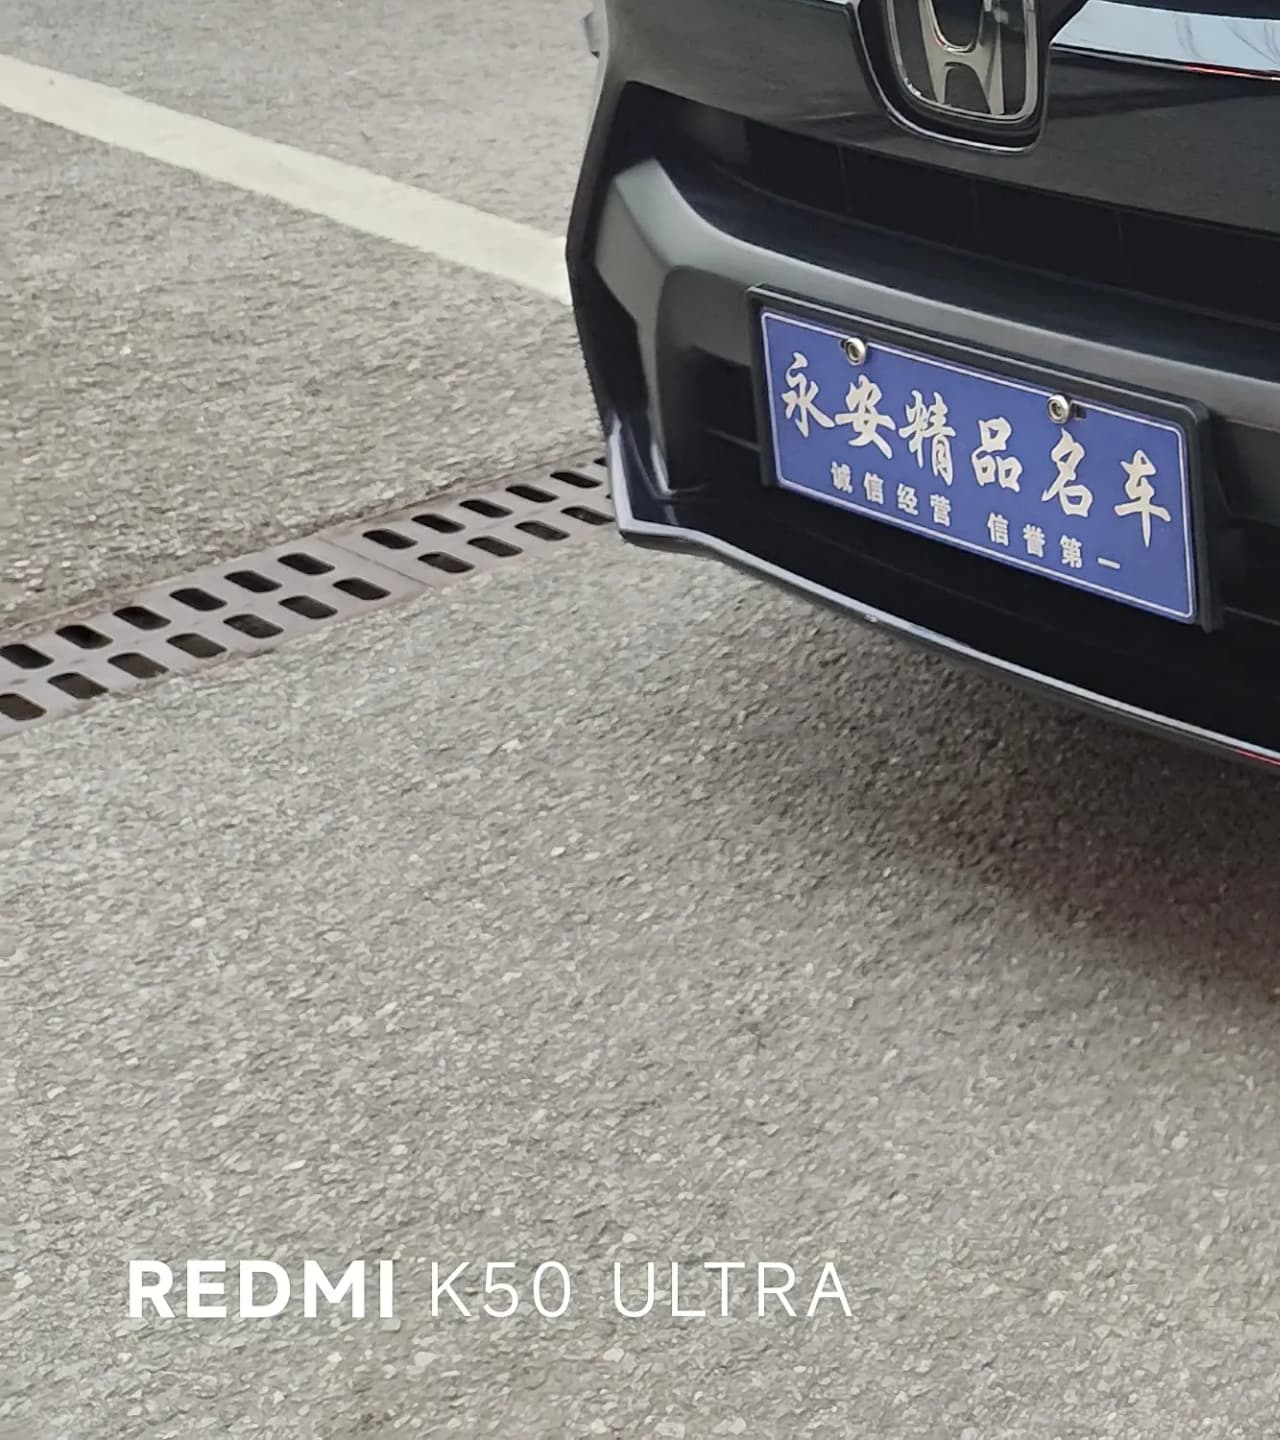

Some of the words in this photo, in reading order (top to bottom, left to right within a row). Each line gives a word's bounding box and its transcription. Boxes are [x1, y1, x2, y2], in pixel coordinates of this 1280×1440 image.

[781, 351, 1172, 549] 永安精品名车
[830, 461, 953, 528] 诚信经营
[986, 511, 1121, 571] 信誉第一
